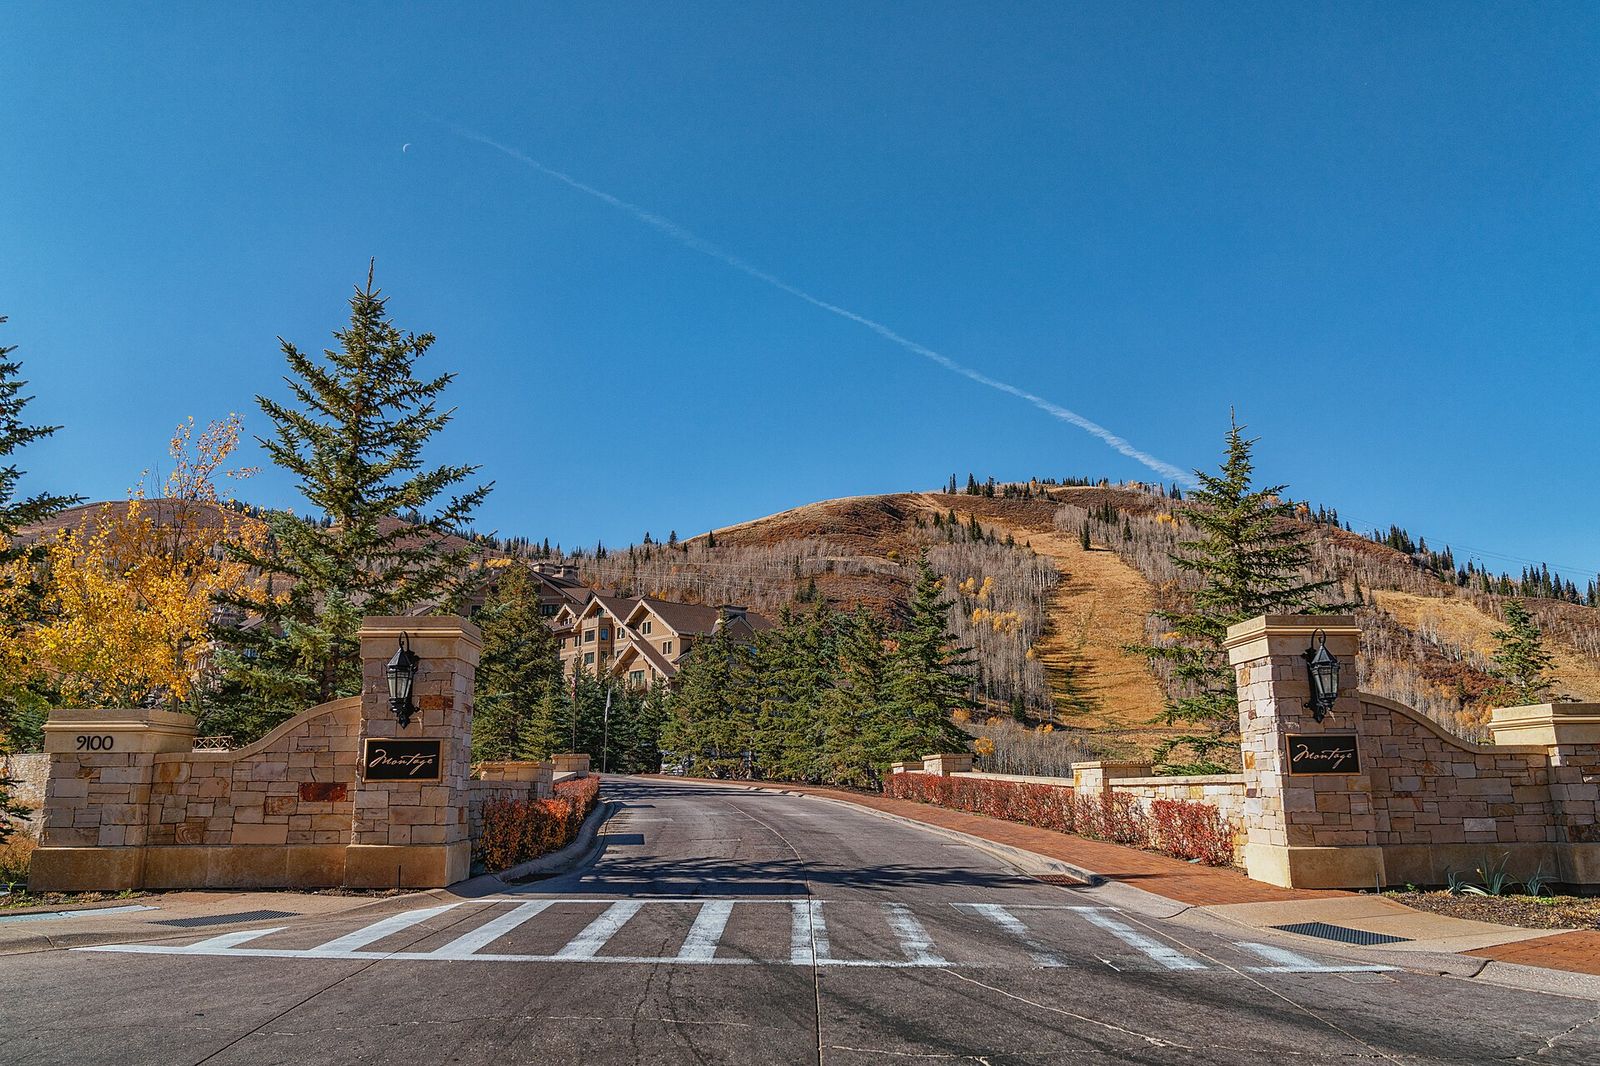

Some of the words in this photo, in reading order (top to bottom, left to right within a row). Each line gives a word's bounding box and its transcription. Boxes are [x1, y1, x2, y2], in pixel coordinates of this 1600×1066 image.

[76, 735, 114, 751] 9100
[1293, 743, 1355, 770] Montage
[369, 748, 437, 776] Montage
